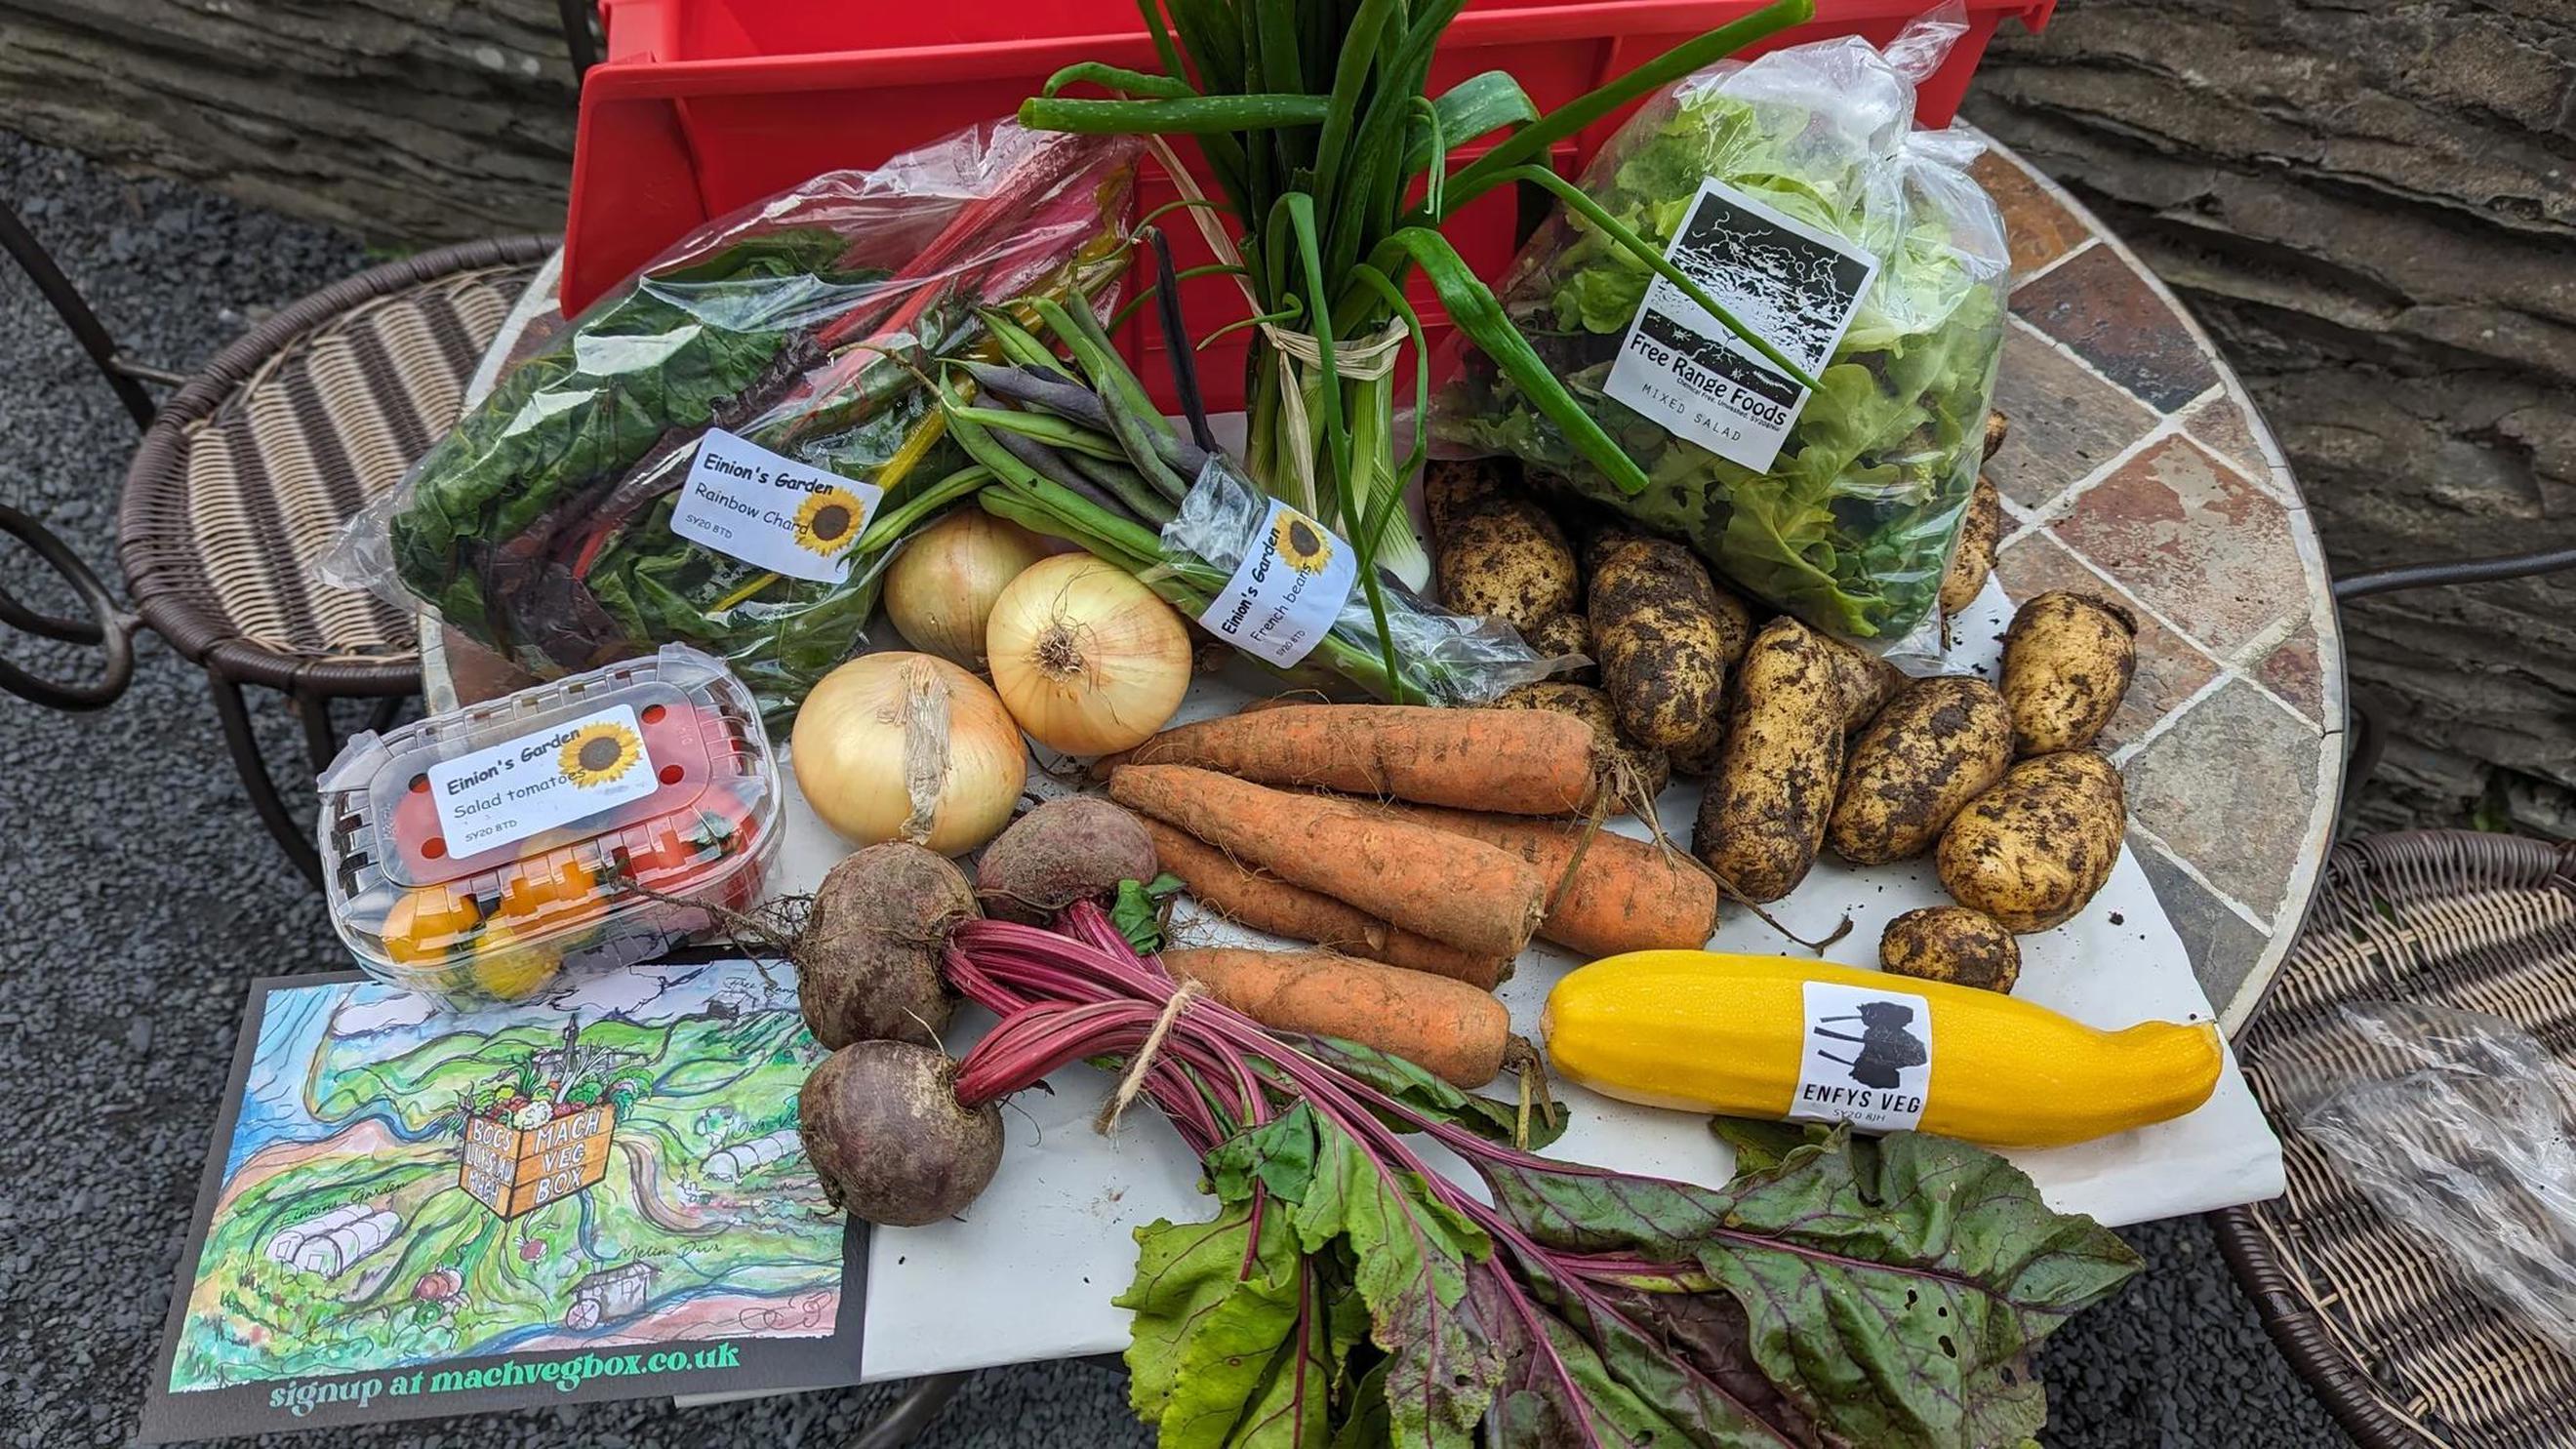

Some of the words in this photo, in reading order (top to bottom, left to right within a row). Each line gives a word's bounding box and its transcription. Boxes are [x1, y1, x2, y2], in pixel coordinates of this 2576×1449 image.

[1630, 333, 1669, 366] Free
[1671, 356, 1727, 397] Range
[1730, 389, 1788, 426] Foods
[1641, 382, 1685, 415] MIXED
[1693, 413, 1742, 442] SALAD
[704, 452, 770, 483] Einion's
[774, 473, 834, 496] Garden
[685, 514, 711, 530] SY20
[695, 482, 760, 519] Rainbow
[762, 510, 810, 536] Chard
[1221, 584, 1259, 634] Einion's
[1252, 527, 1281, 584] Garden
[1250, 604, 1289, 642] French
[1283, 562, 1311, 604] beans
[446, 757, 515, 796] Einion's
[520, 729, 582, 763] Garden
[454, 792, 503, 820] Salad
[506, 768, 586, 801] tomatoes
[464, 826, 494, 843] SY20
[1803, 1083, 1872, 1108] ENFYS
[1880, 1093, 1920, 1113] VEG
[472, 1118, 513, 1152] BOCS
[534, 1108, 603, 1154] MACH
[543, 1142, 585, 1174] VEG
[536, 1166, 584, 1204] BOX
[268, 1377, 383, 1418] signup
[389, 1370, 424, 1397] at
[429, 1341, 741, 1393] machvegbox.co.uk
